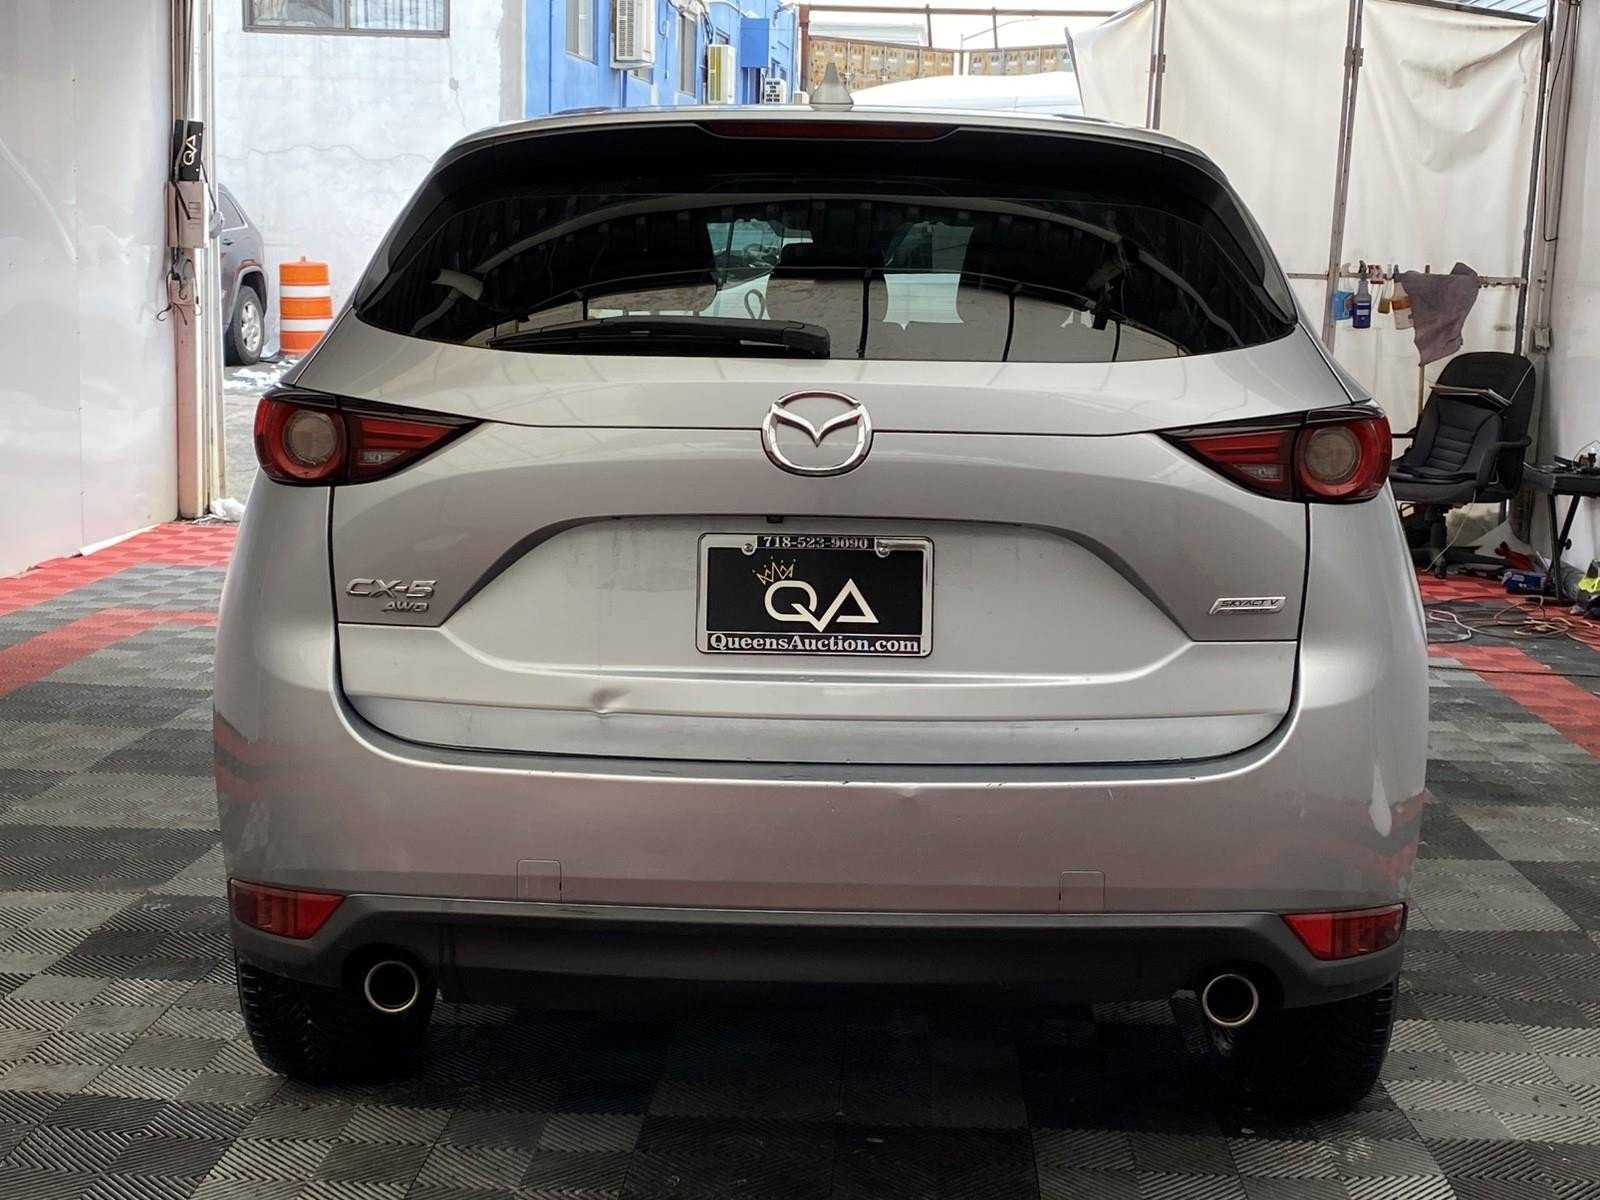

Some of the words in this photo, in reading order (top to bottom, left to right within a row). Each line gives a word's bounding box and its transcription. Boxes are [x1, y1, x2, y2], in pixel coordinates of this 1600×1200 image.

[763, 535, 869, 549] 718-523-9090
[346, 578, 437, 598] CX-5
[382, 601, 429, 612] AWD
[764, 578, 879, 632] QA
[1220, 599, 1279, 607] SKYACTV
[709, 633, 919, 652] QueensAuction.com
